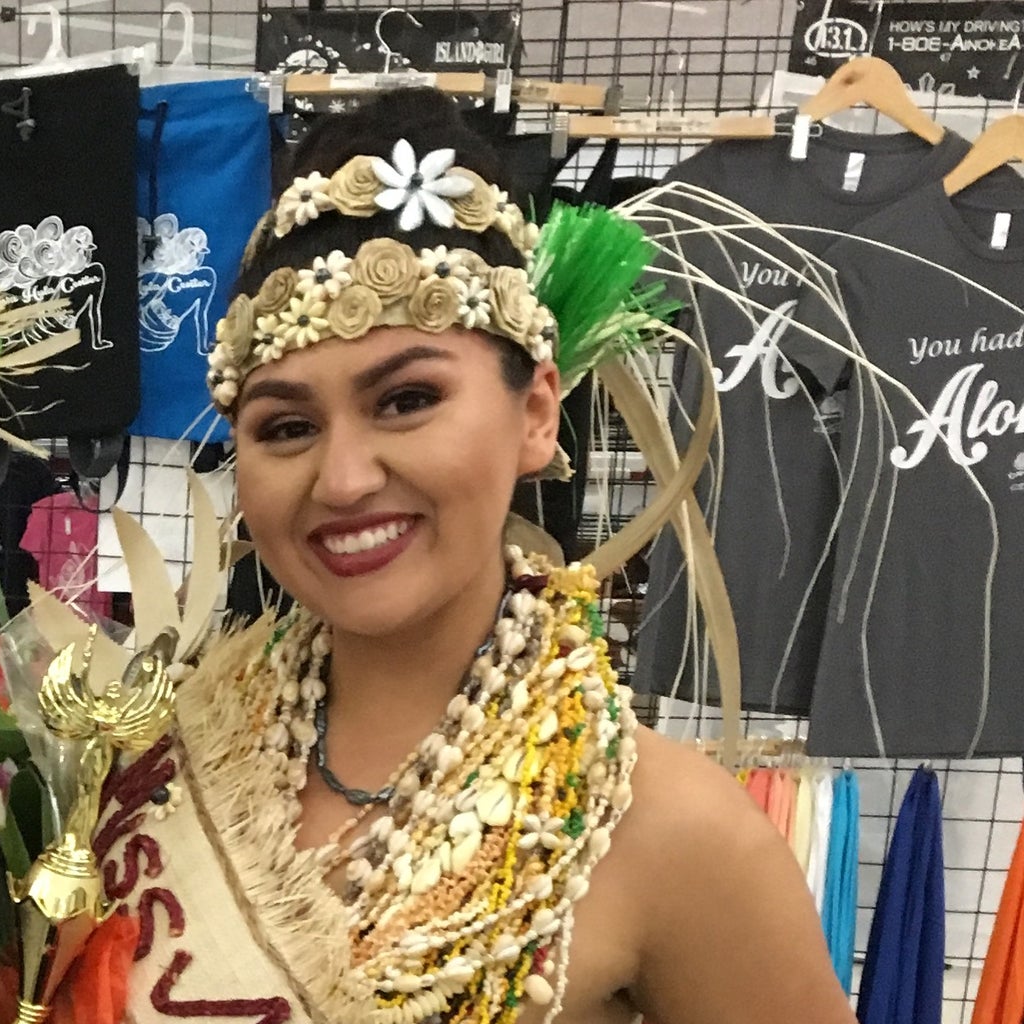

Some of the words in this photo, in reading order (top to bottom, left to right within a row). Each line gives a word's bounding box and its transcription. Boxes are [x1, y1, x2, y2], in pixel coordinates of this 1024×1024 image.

[939, 20, 961, 33] MY
[963, 20, 1024, 33] DRIVING
[908, 336, 960, 365] You
[971, 327, 1024, 353] had
[890, 363, 1024, 469] Alo
